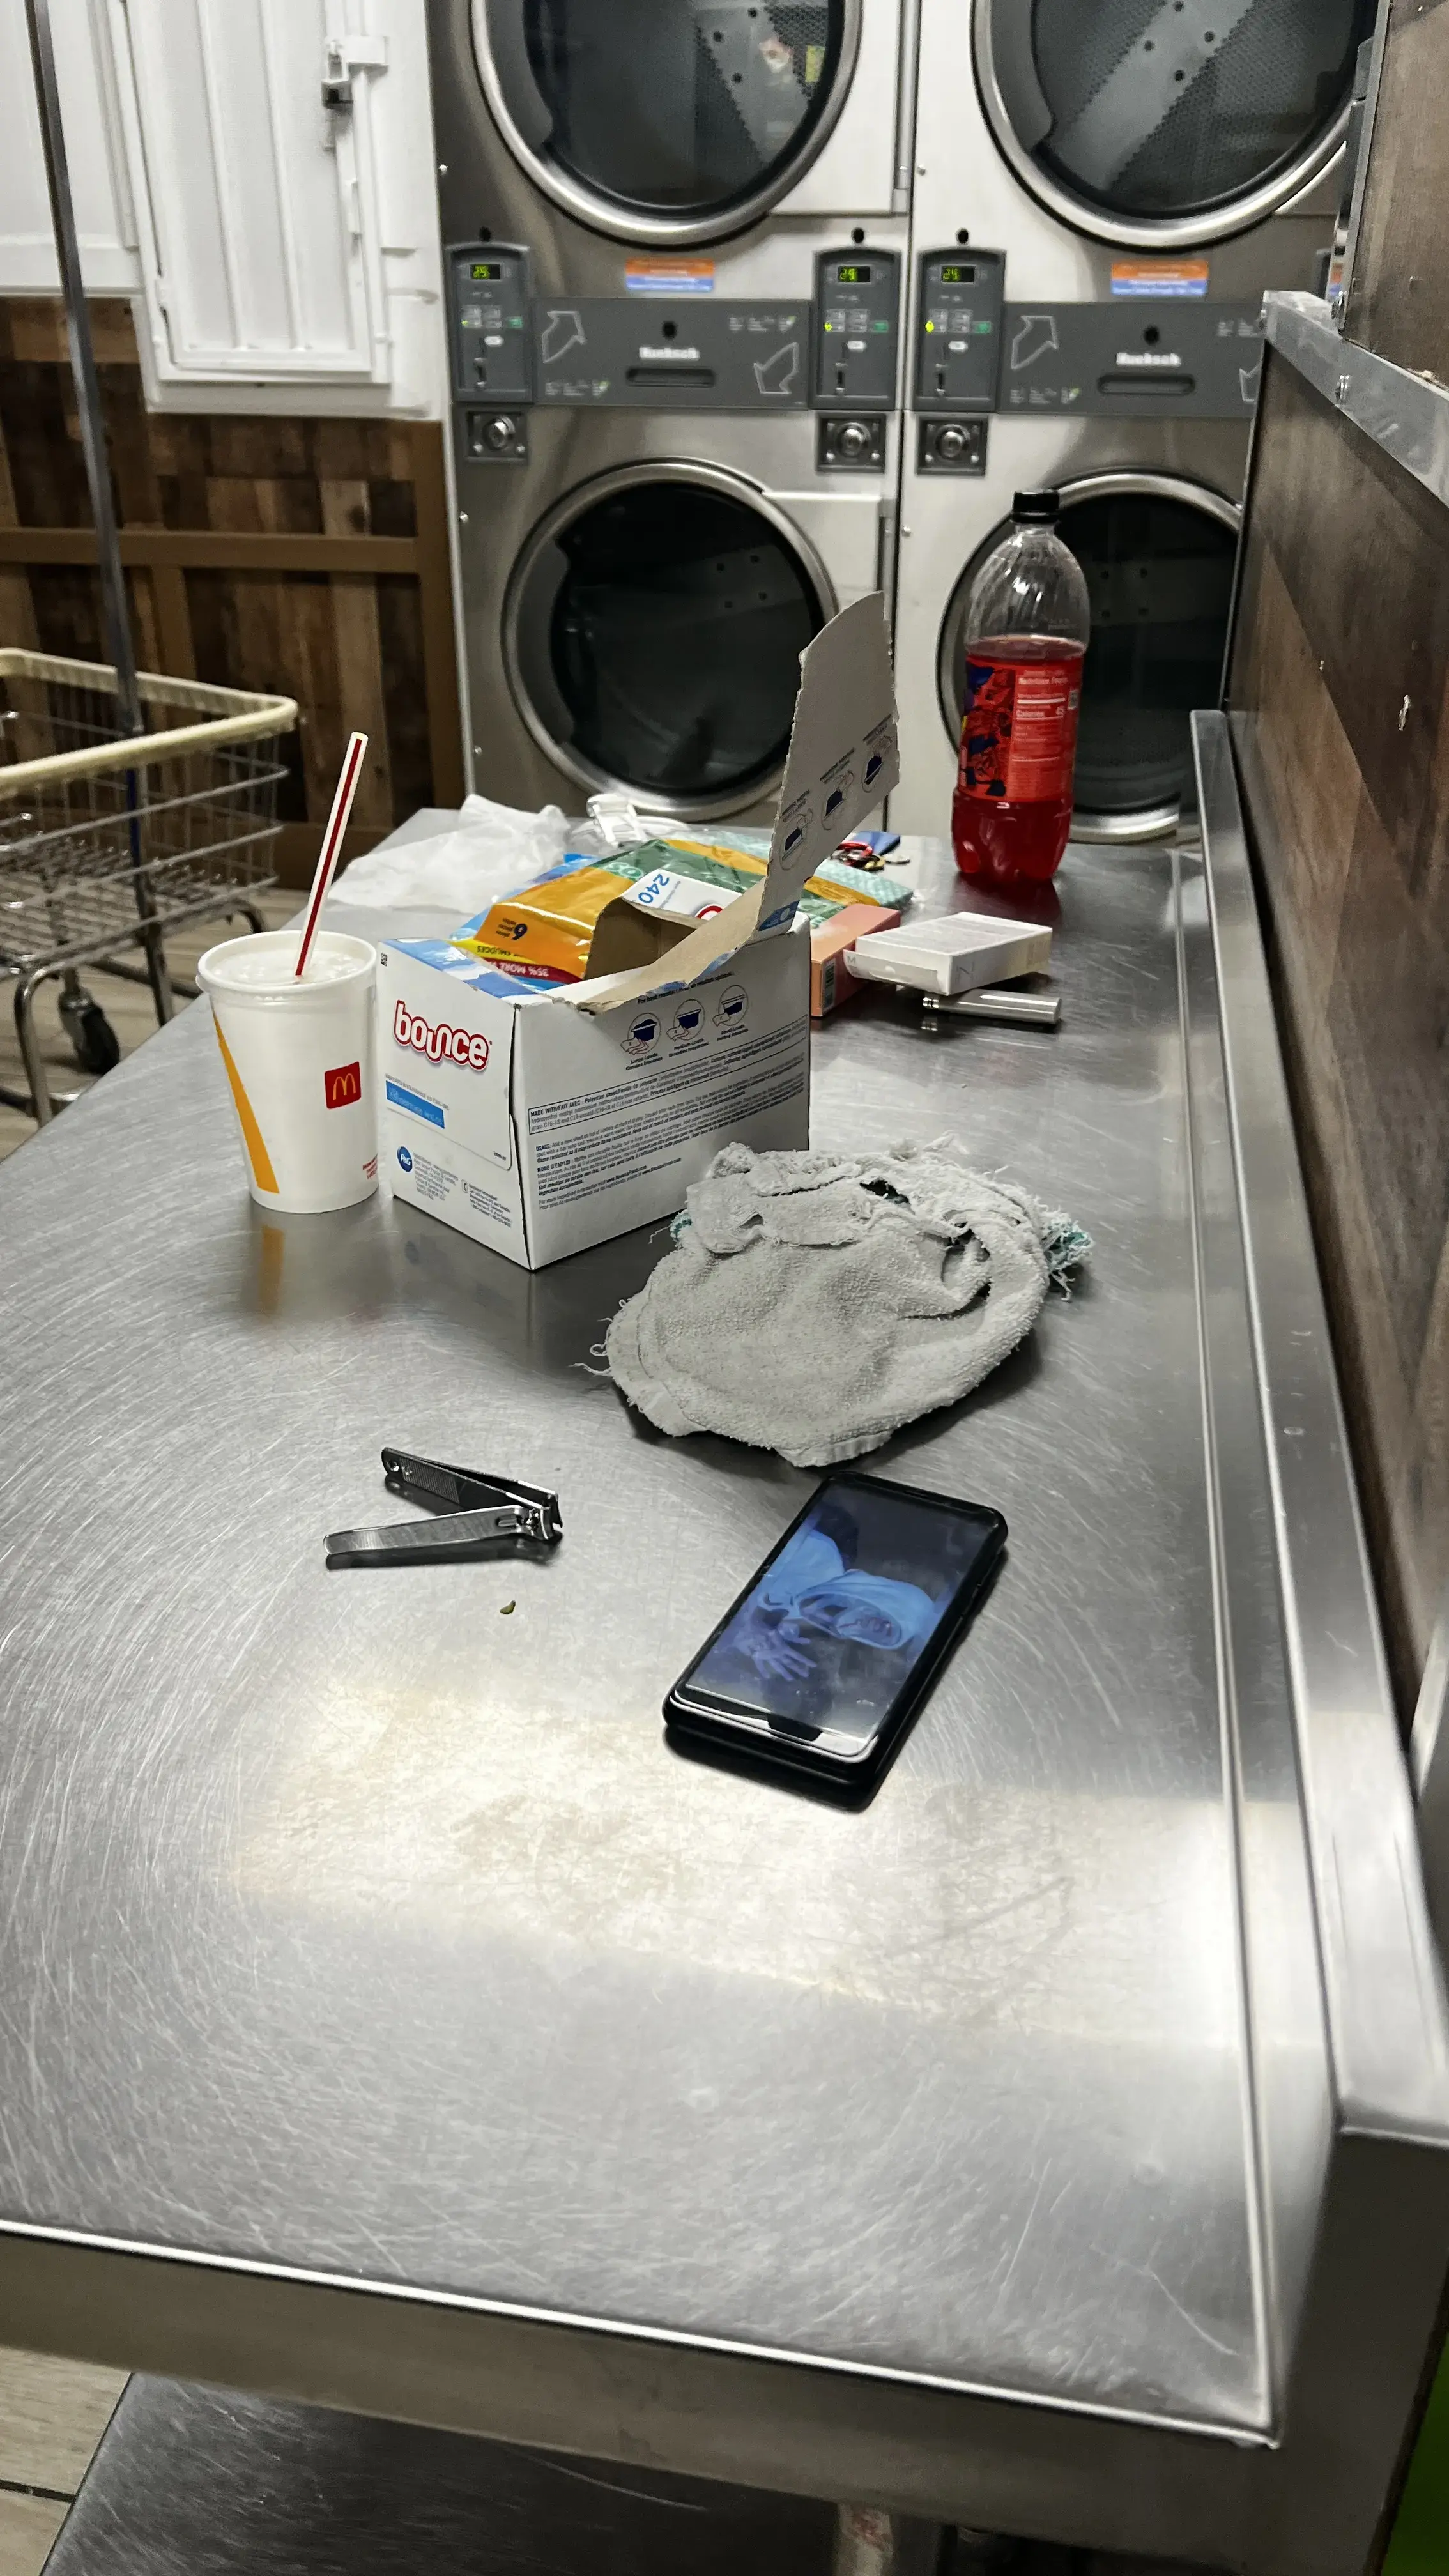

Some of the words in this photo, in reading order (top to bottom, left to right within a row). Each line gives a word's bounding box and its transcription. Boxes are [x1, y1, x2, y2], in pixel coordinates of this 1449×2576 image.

[638, 874, 670, 903] 240
[512, 924, 528, 940] 6
[499, 962, 527, 974] MORE
[528, 967, 549, 977] 35%
[394, 1000, 489, 1070] bounce
[545, 1104, 567, 1114] WITH/FAIT
